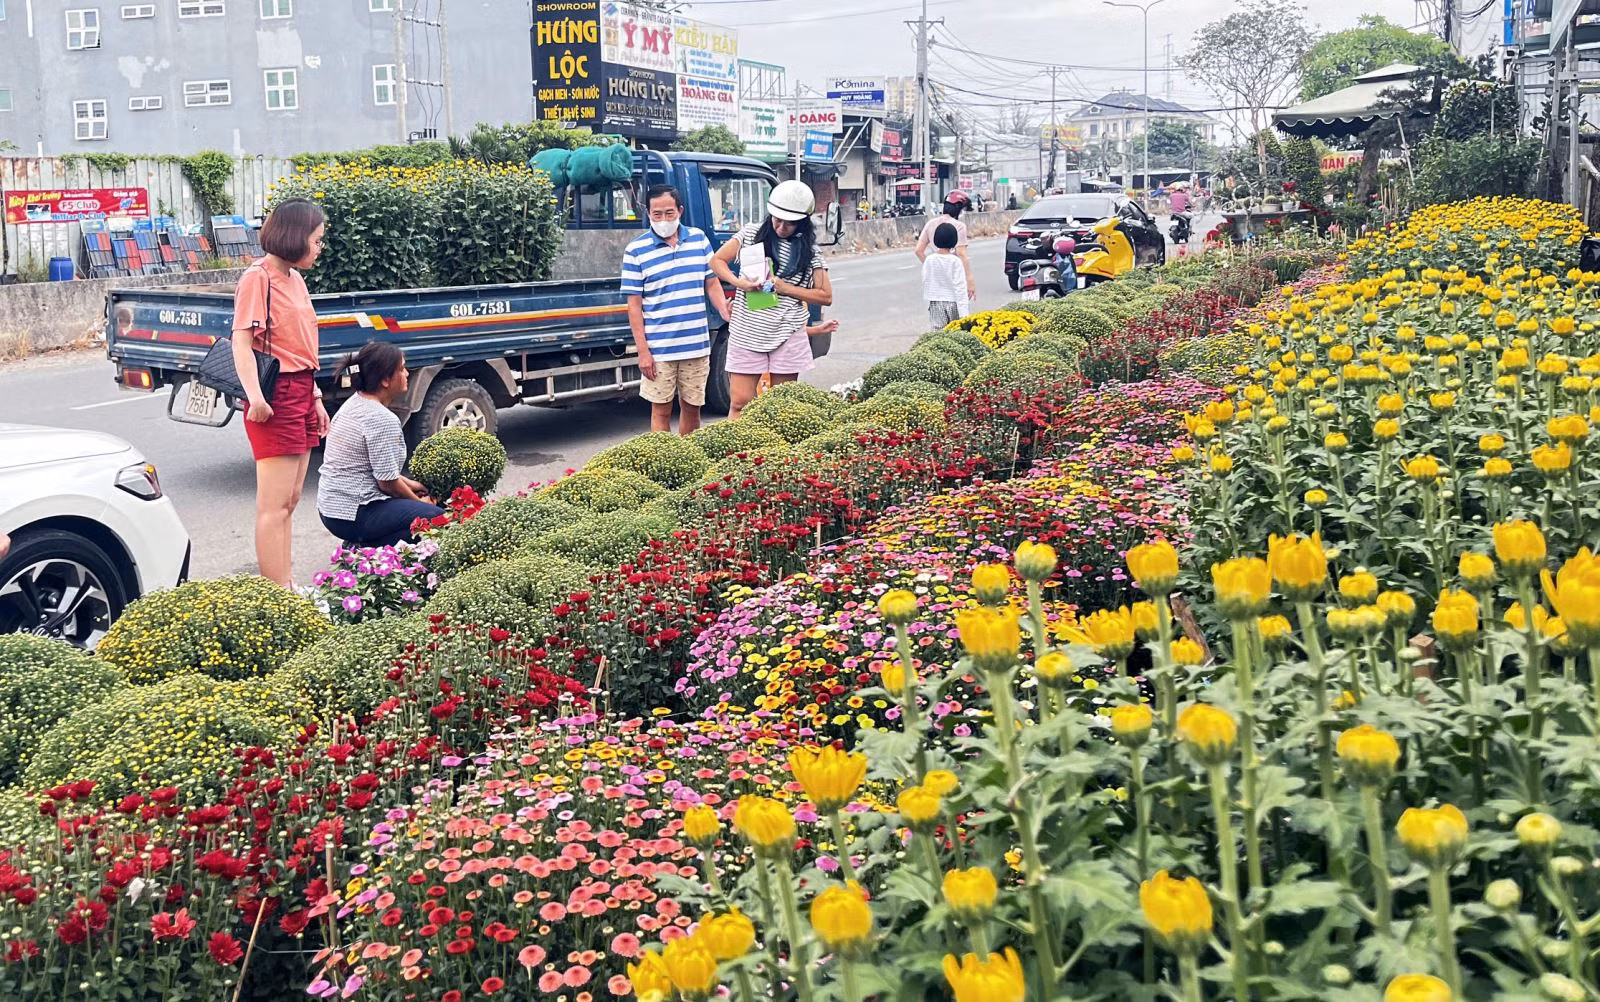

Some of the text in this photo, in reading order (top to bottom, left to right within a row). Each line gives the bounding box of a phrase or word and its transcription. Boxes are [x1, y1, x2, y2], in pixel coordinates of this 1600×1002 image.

[537, 2, 596, 11] SHOWROOM
[537, 17, 597, 46] HƯNG
[549, 50, 589, 84] LỘC
[538, 88, 554, 102] GẠCH
[554, 88, 568, 100] MEN
[608, 77, 646, 99] HƯNG
[649, 80, 675, 105] LỘC
[682, 86, 733, 103] HOÀNG GIA
[580, 106, 596, 119] SINH
[62, 201, 98, 210] F5 Club
[450, 300, 512, 317] 60L-7581
[159, 309, 203, 326] 60L-7581
[188, 397, 210, 415] 7581
